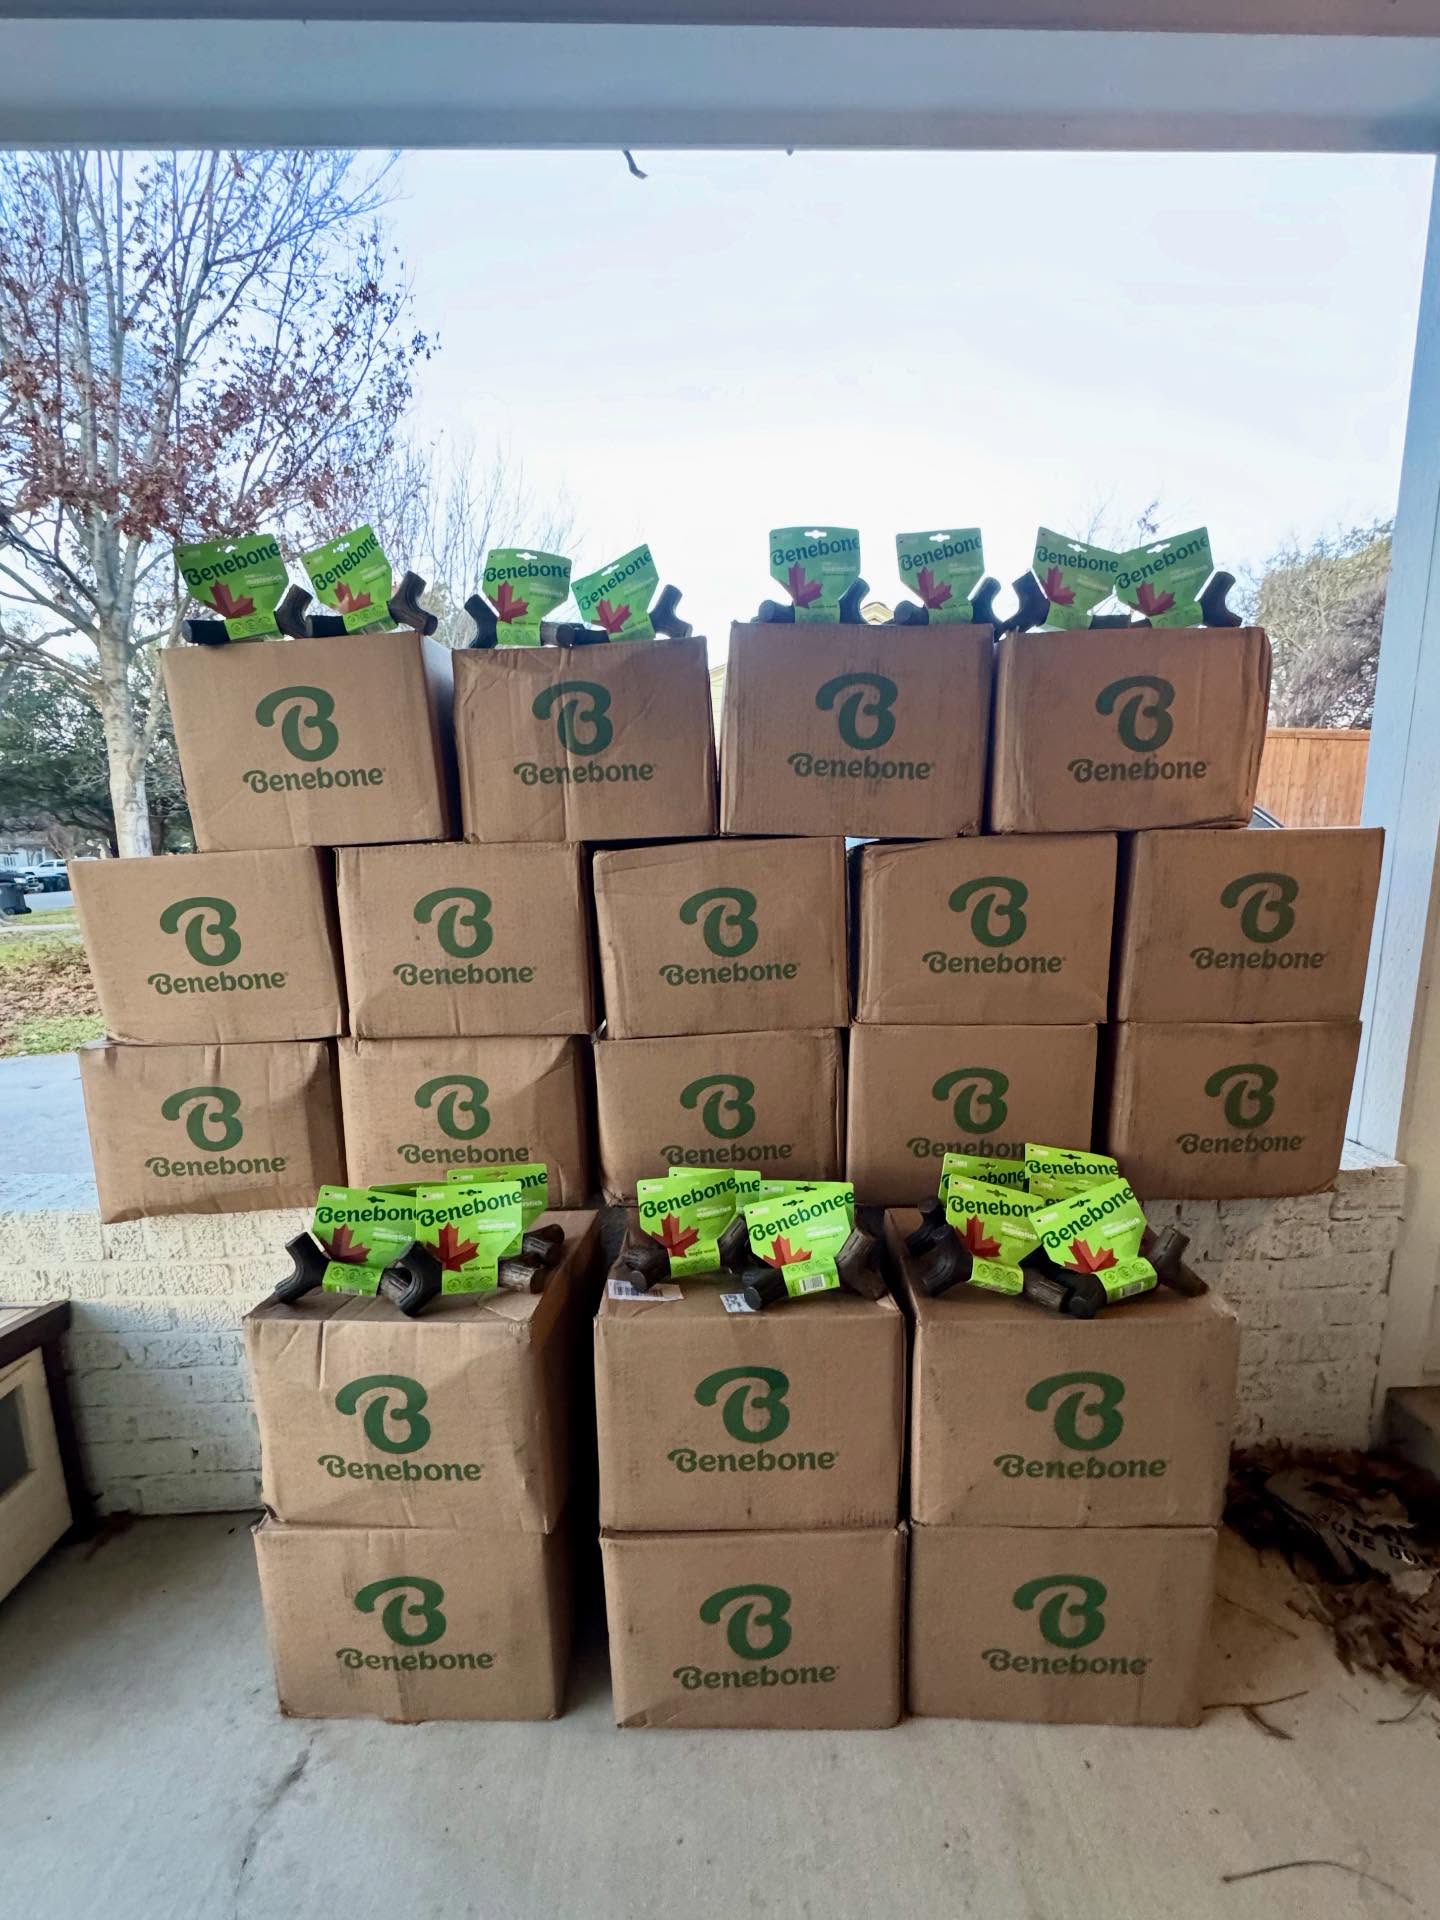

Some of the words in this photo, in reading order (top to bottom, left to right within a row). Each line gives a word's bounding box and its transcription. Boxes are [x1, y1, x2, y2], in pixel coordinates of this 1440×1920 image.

[183, 541, 280, 586] Benebone
[310, 532, 379, 591] Benebone
[770, 536, 860, 566] Benebone
[898, 534, 982, 571] Benebone
[1036, 546, 1119, 573] Benebone
[1114, 535, 1208, 589] Benebone
[484, 562, 570, 582] Benebone
[578, 550, 653, 611] Benebone
[513, 761, 654, 785] Benebone
[787, 752, 931, 780] Benebone
[1067, 758, 1207, 783] Benebone
[242, 766, 384, 793] Benebone
[923, 951, 1063, 974] Benebone
[1190, 947, 1325, 970] Benebone
[147, 971, 285, 995] Benebone
[393, 963, 534, 985] Benebone
[659, 962, 798, 987] Benebone
[397, 1144, 530, 1164] Benebone
[660, 1143, 792, 1165] Benebone
[906, 1137, 1025, 1158] Benebon
[1176, 1132, 1303, 1155] Benebone
[145, 1156, 286, 1178] Benebone
[1025, 1159, 1120, 1178] Benebone
[416, 1190, 523, 1227] Benebone
[640, 1177, 736, 1218] Benebone
[315, 1206, 417, 1224] Benebon
[1041, 1186, 1135, 1249] Benebone
[317, 1454, 482, 1481] Benebone
[667, 1448, 837, 1473] Benebone
[993, 1454, 1167, 1480] Benebone
[336, 1648, 494, 1671] Benebone
[982, 1648, 1147, 1675] Benebone
[673, 1665, 836, 1690] Benebone
